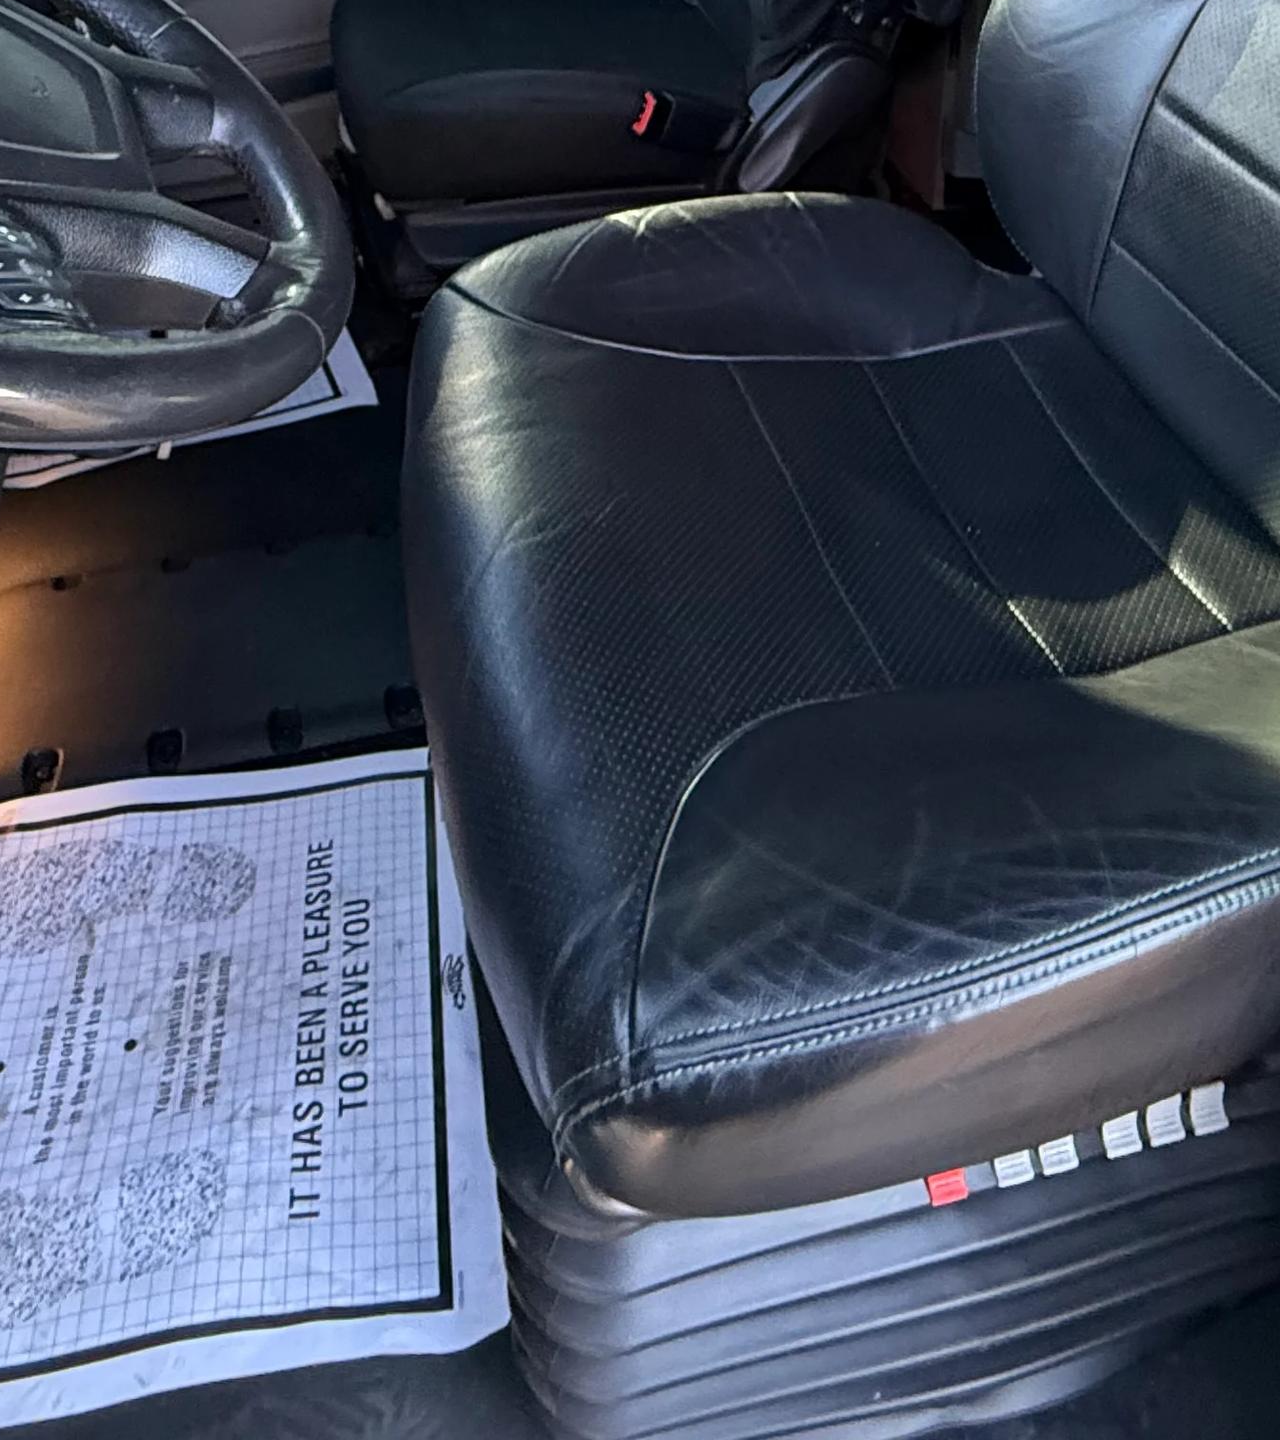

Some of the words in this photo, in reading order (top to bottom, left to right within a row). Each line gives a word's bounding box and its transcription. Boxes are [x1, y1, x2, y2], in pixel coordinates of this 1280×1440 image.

[301, 838, 335, 973] PLEASURE
[342, 898, 372, 957] YOU
[305, 980, 329, 998] A
[338, 960, 370, 1057] SERVE
[29, 1025, 56, 1102] customer
[49, 1009, 79, 1091] important
[295, 1007, 328, 1088] BEEN
[338, 1070, 369, 1118] TO
[290, 1099, 325, 1174] HAS
[288, 1186, 321, 1221] IT
